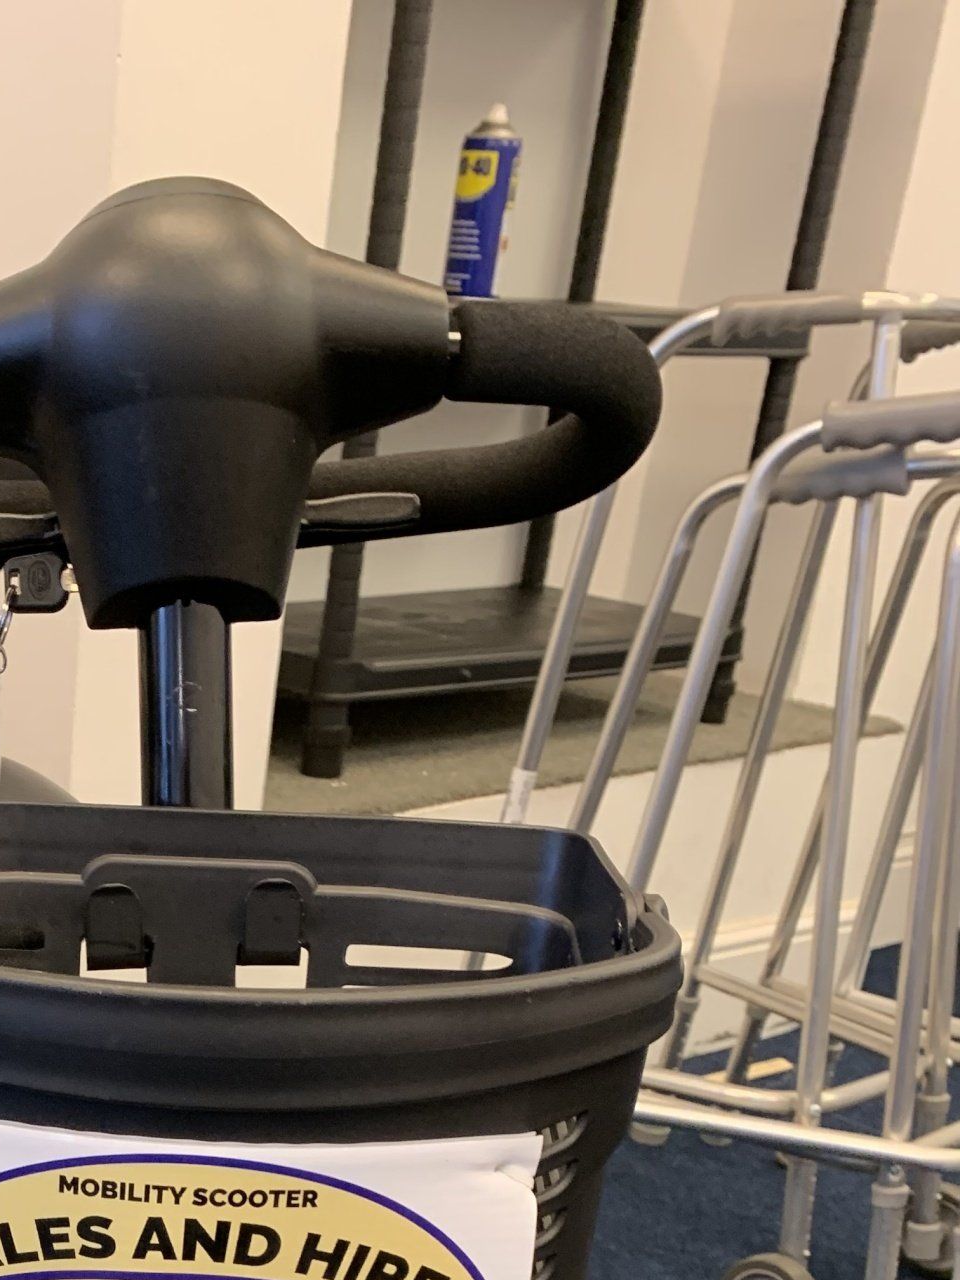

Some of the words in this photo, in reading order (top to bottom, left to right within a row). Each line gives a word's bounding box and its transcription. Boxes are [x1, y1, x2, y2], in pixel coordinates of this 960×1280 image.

[57, 1173, 188, 1206] MOBILITY
[191, 1186, 319, 1209] SCOOTER
[132, 1216, 283, 1268] AND
